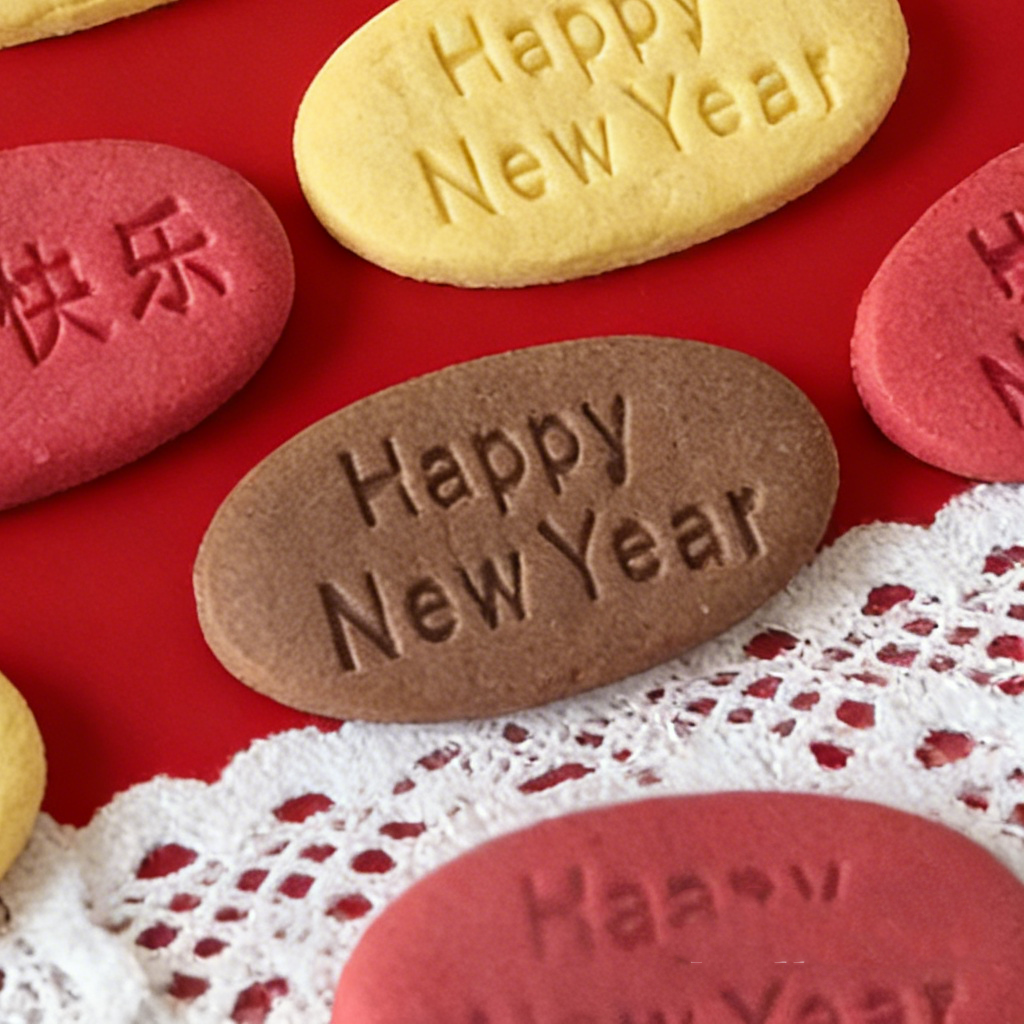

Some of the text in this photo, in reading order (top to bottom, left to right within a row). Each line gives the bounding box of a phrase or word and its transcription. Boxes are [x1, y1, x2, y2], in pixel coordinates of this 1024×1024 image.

[414, 45, 839, 225] New Year
[339, 393, 629, 527] Happy
[318, 486, 766, 672] New Year
